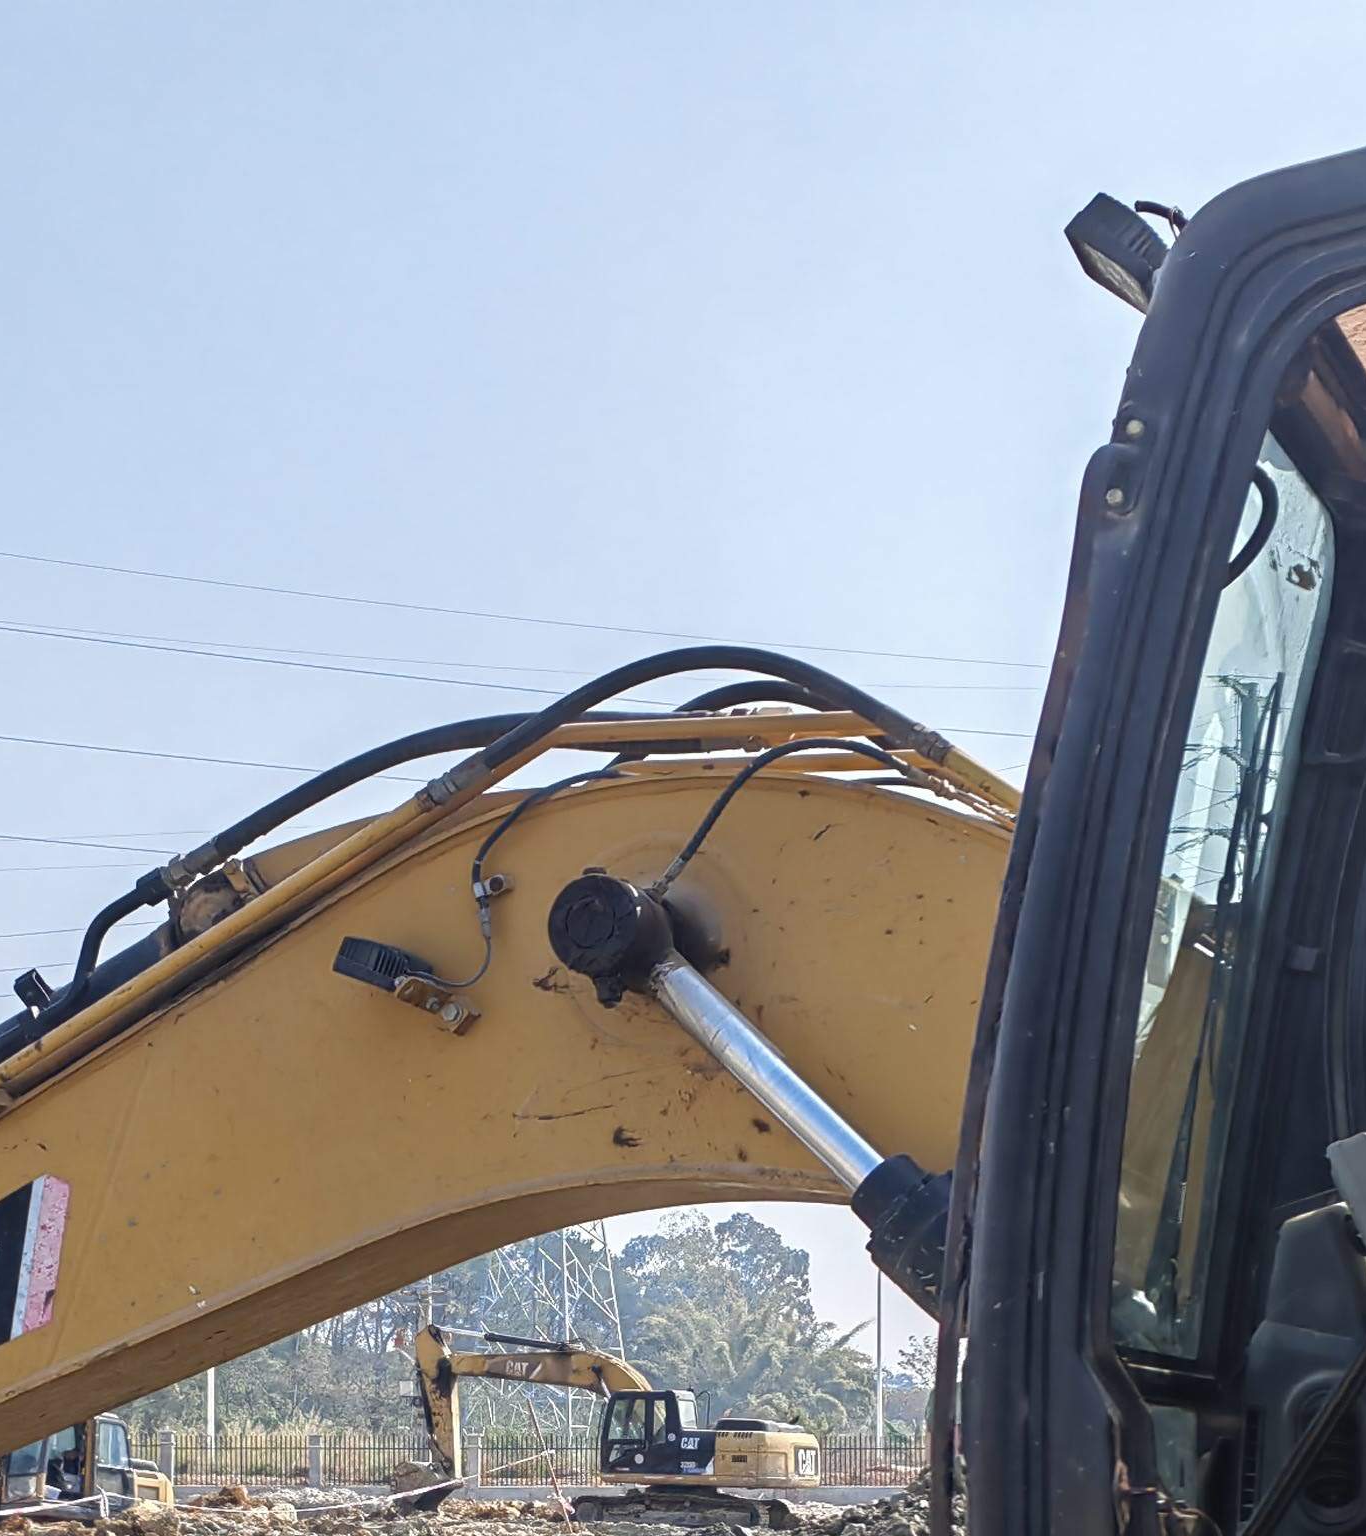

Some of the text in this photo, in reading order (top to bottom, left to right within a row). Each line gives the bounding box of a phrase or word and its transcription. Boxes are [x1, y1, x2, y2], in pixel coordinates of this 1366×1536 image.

[506, 1360, 529, 1377] CAT
[680, 1437, 700, 1449] CAT
[797, 1448, 817, 1476] CAT
